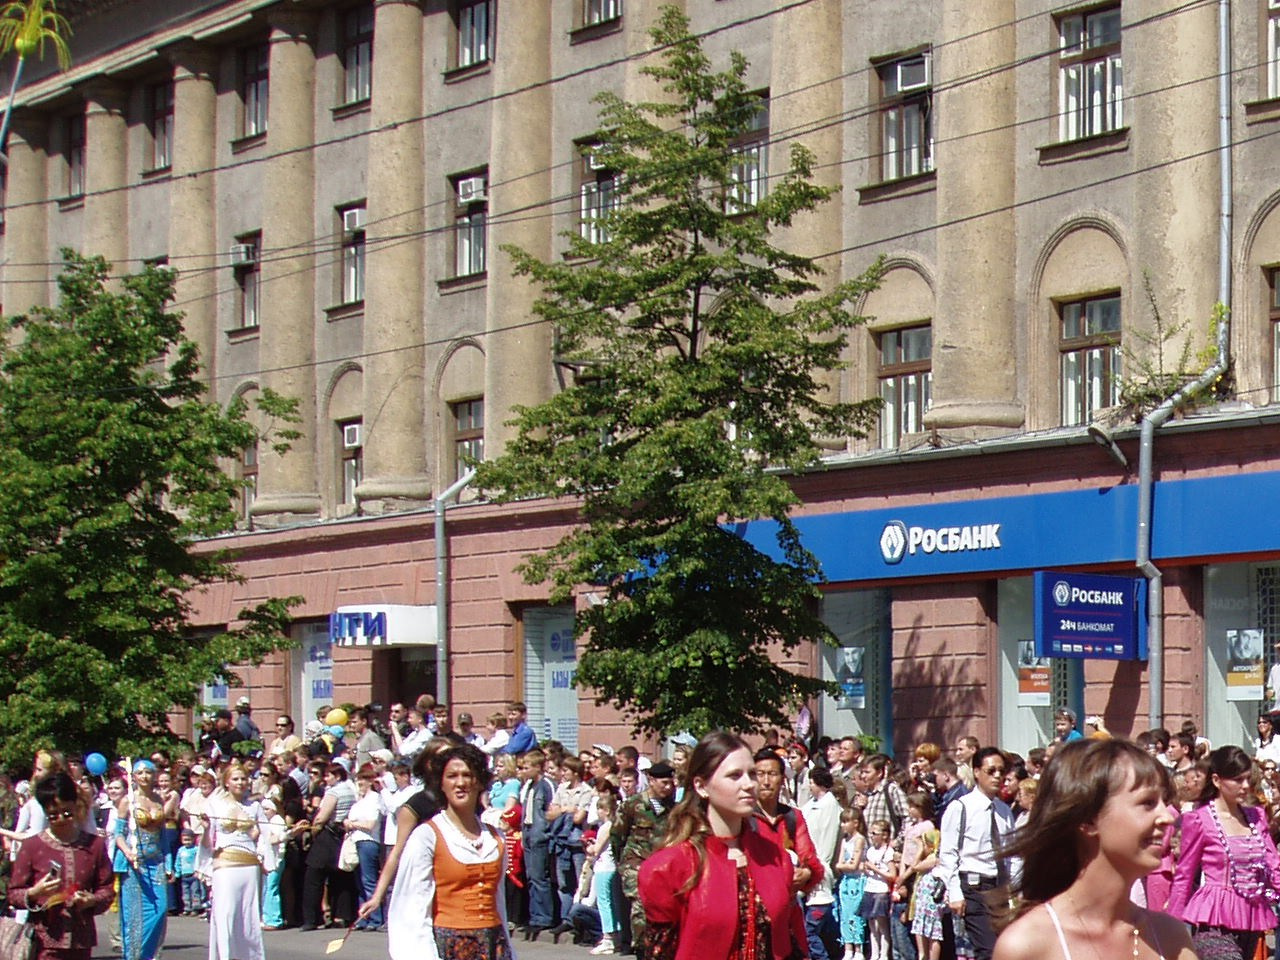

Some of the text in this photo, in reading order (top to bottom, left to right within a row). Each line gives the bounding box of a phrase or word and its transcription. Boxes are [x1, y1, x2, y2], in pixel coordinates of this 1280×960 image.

[908, 523, 1001, 554] РОСБАНК
[1071, 587, 1123, 605] РОСБАНК
[1077, 621, 1114, 632] БАНКОМАТ
